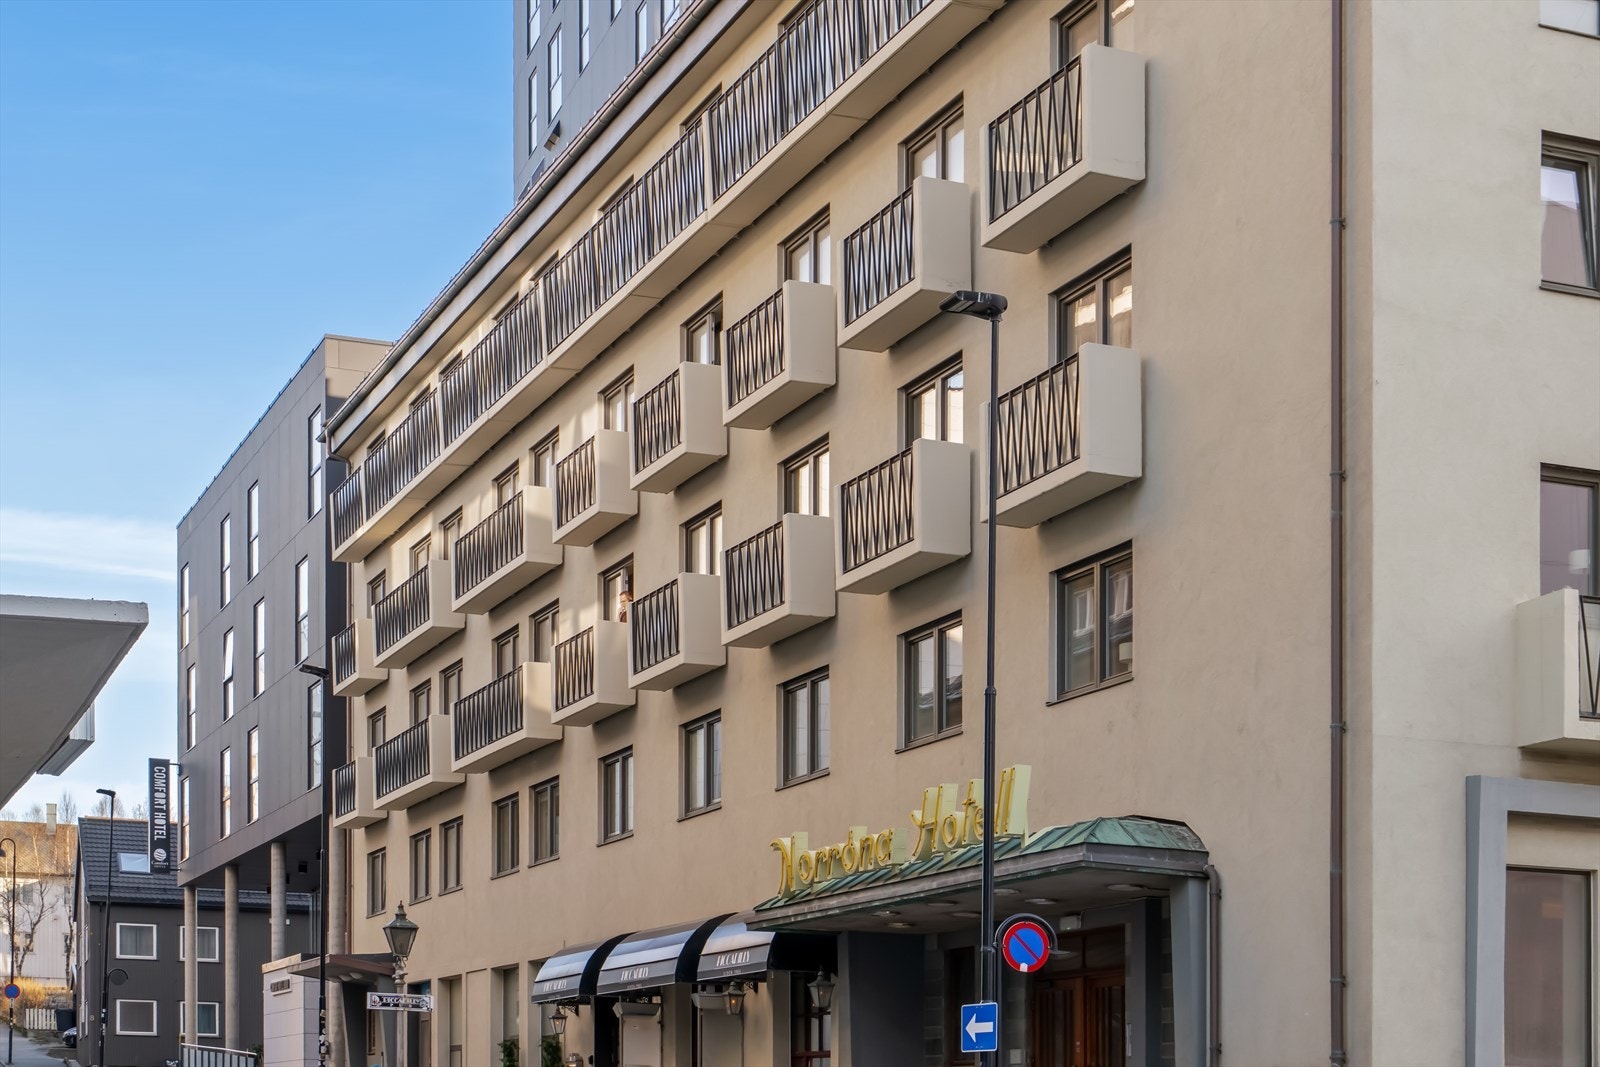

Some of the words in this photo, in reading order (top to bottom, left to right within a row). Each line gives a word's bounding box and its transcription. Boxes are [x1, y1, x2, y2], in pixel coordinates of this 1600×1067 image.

[154, 766, 166, 810] COMFORT
[154, 812, 166, 840] HOTEL
[910, 765, 1027, 862] Hotell
